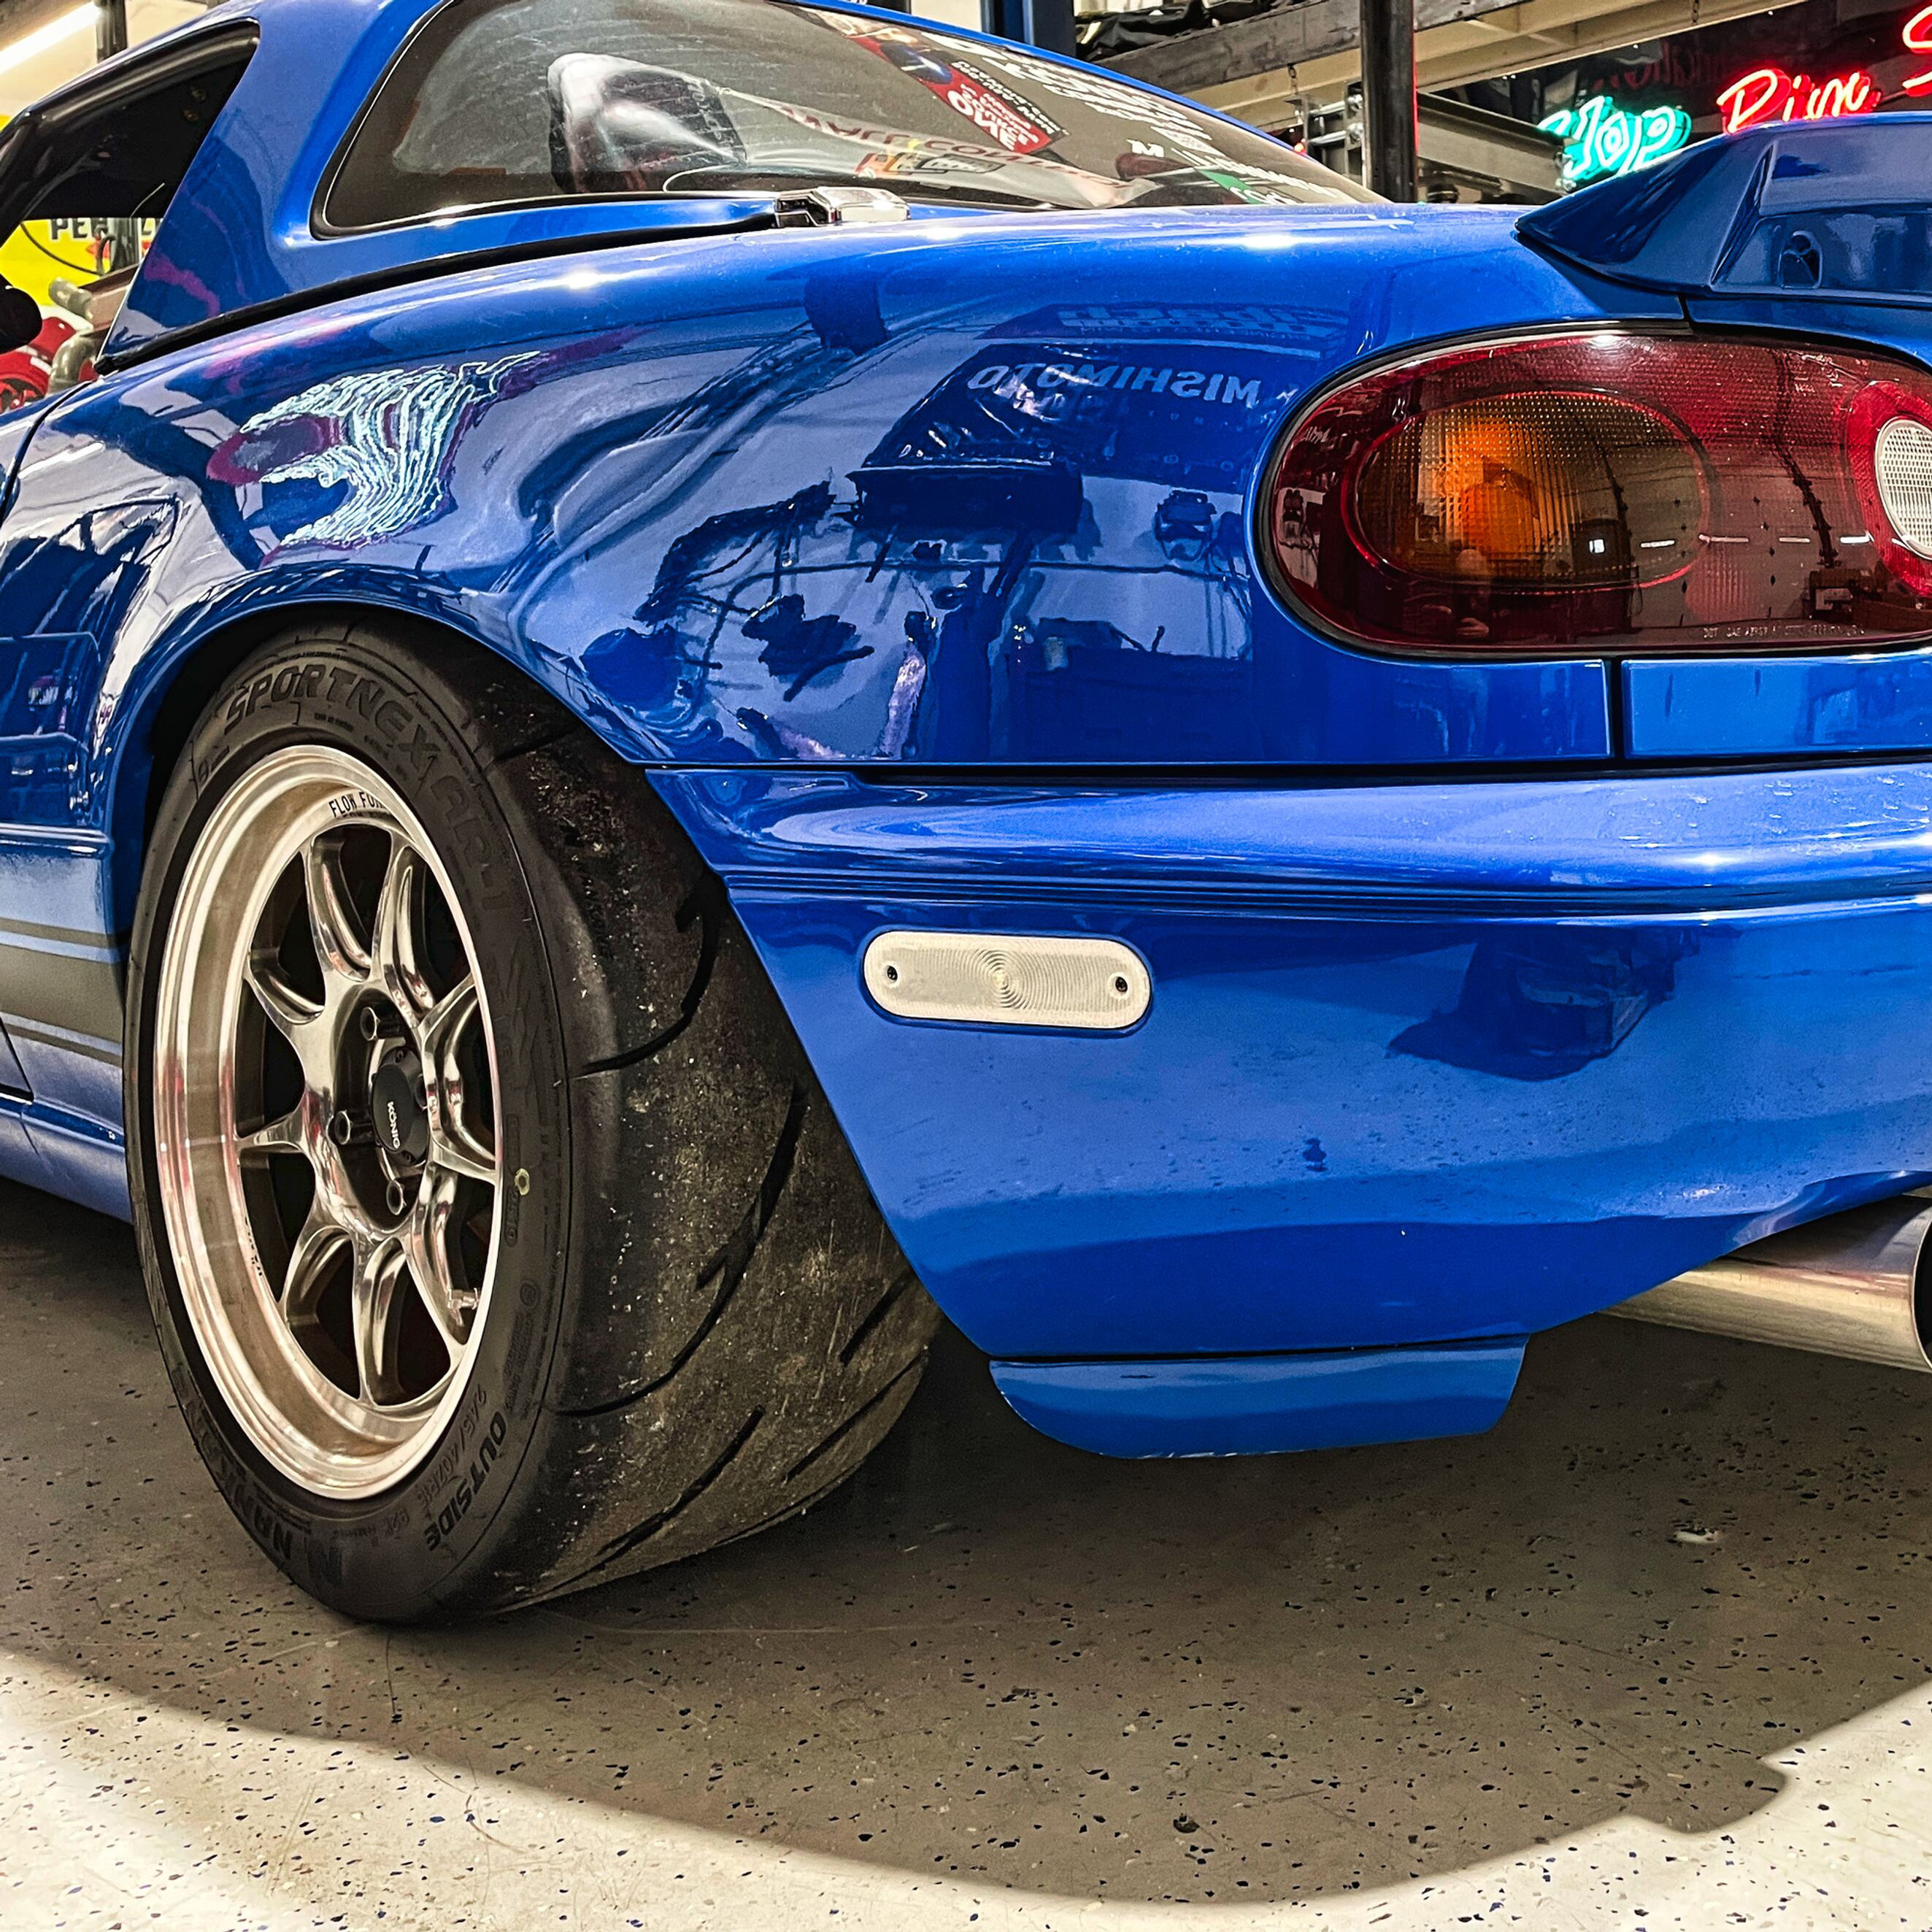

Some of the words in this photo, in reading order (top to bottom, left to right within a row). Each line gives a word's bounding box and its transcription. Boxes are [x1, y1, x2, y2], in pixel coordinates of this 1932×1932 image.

[224, 663, 442, 774] SPORTNEX
[328, 792, 358, 818] FLOW
[424, 1410, 507, 1551] OUTSIDE
